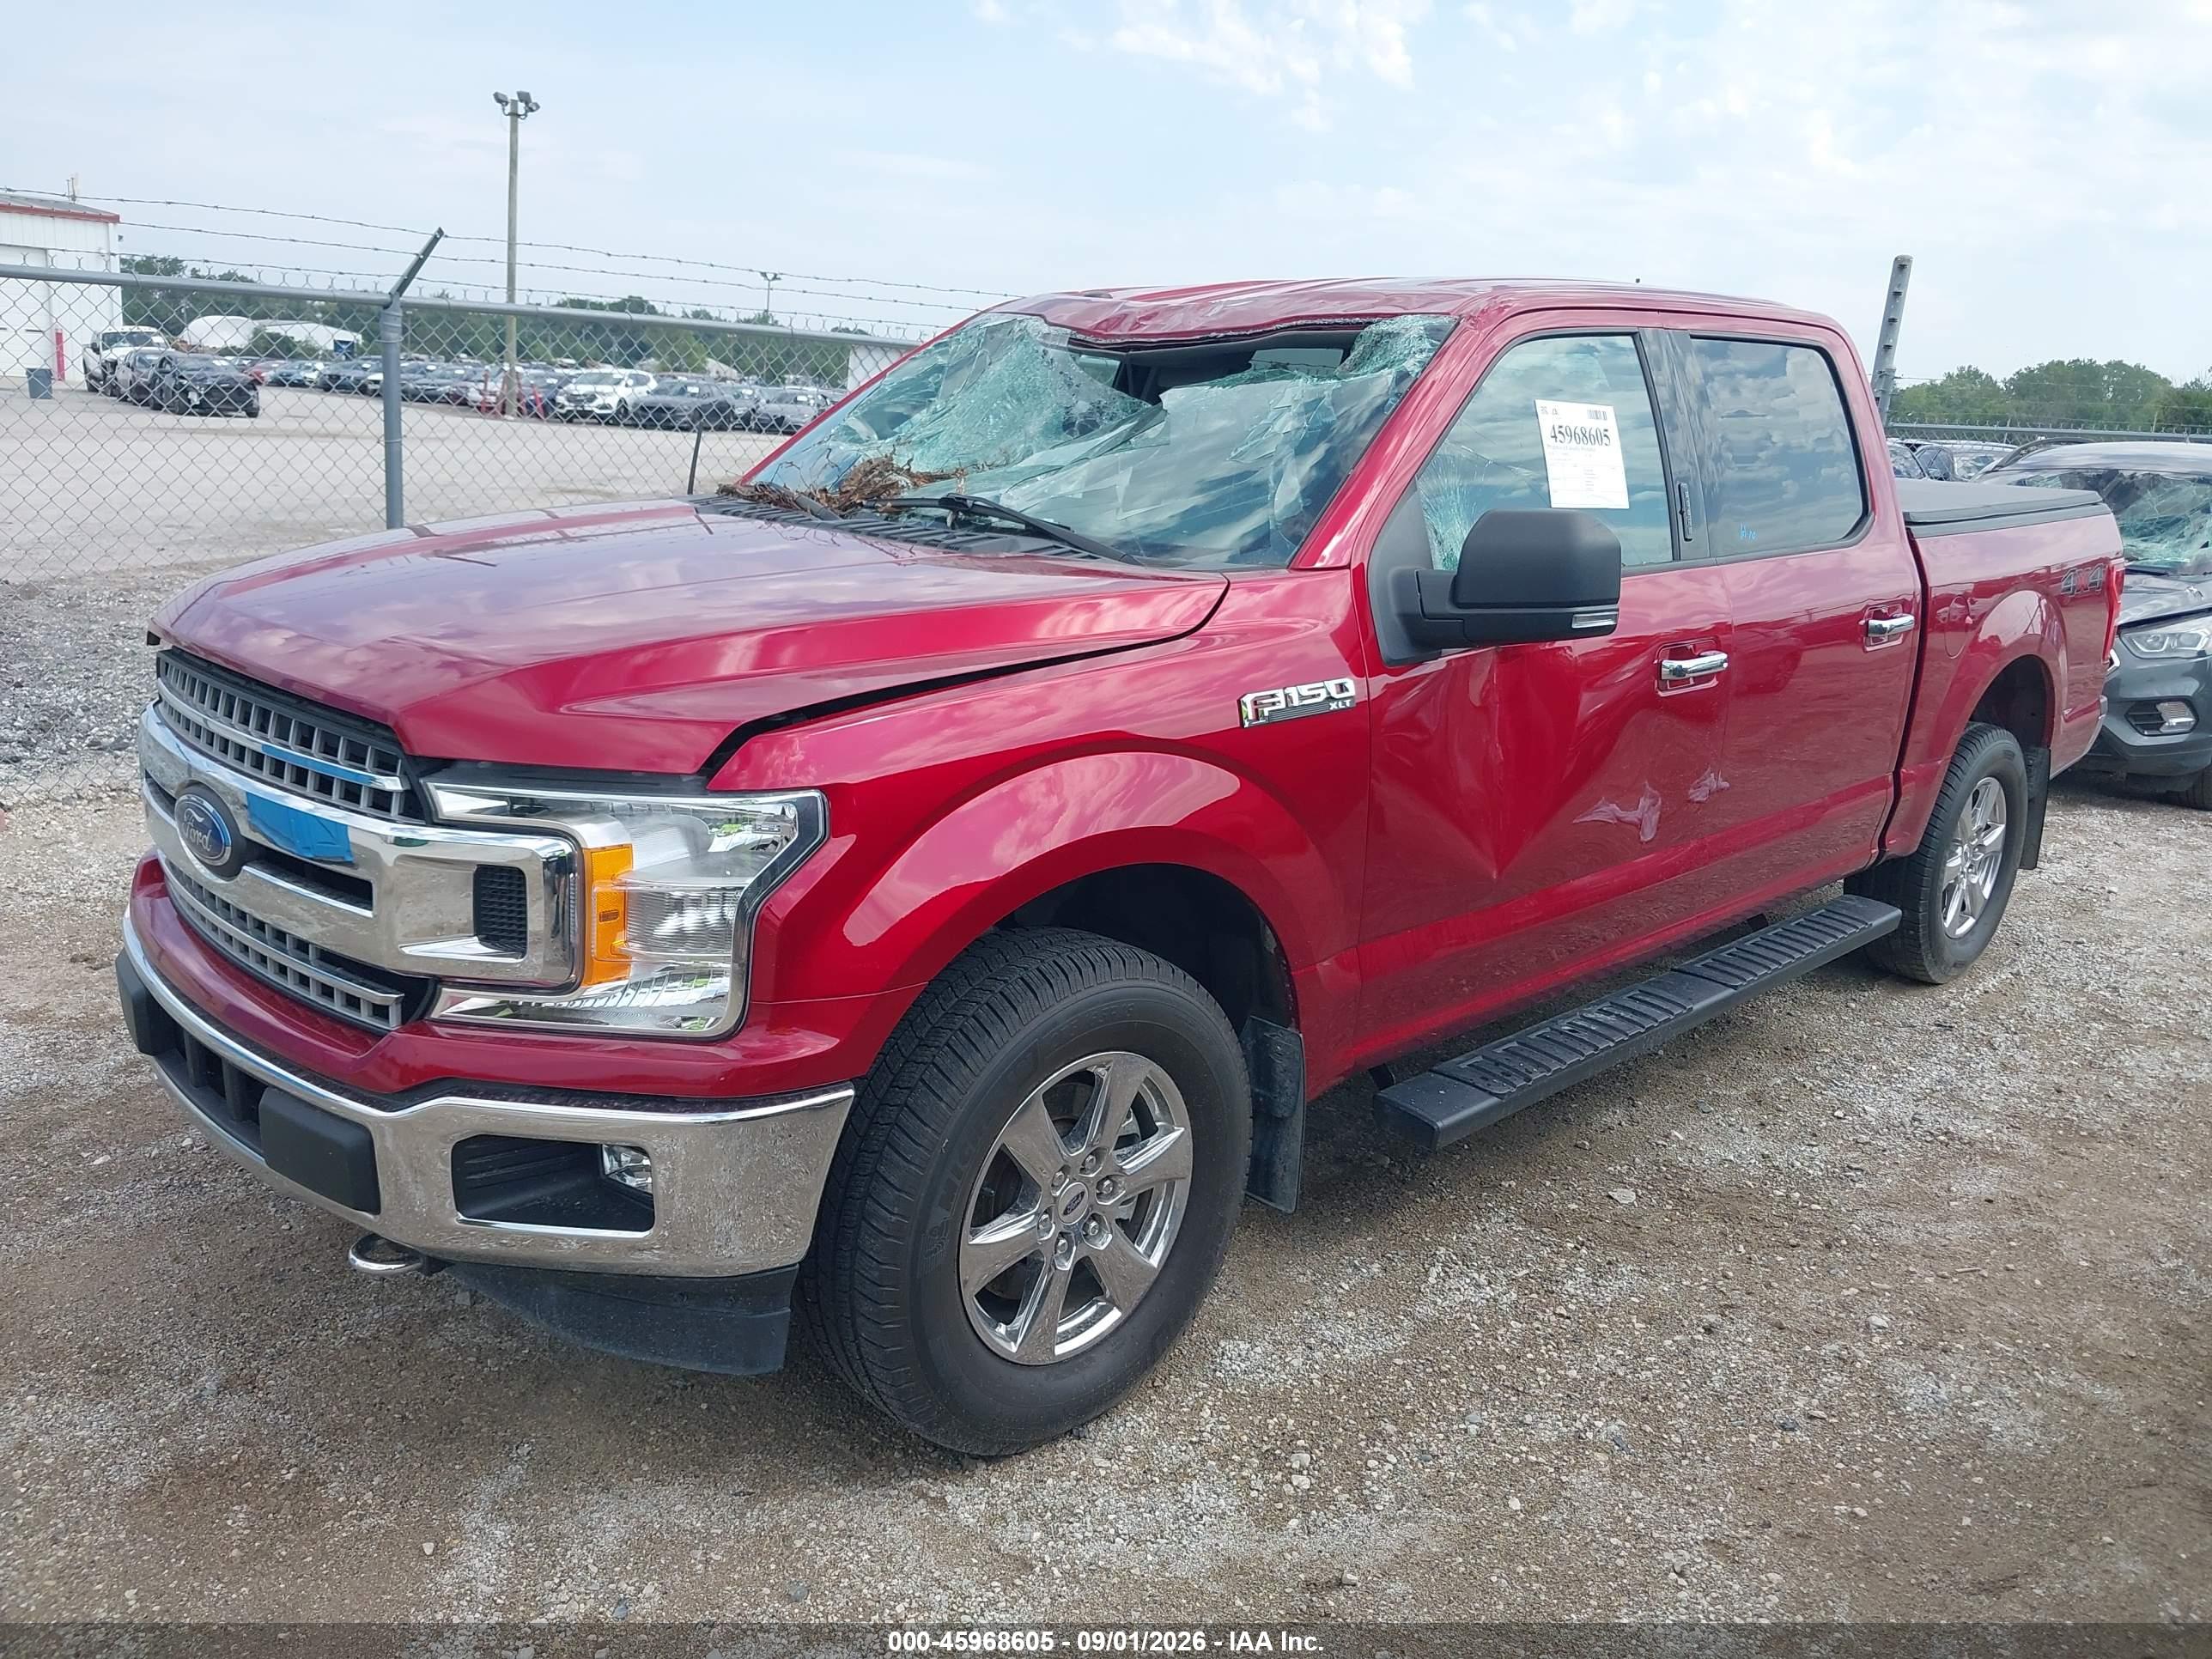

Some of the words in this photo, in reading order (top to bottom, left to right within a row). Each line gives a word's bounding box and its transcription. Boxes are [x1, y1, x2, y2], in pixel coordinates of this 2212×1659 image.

[1549, 424, 1611, 447] 45968605
[1328, 699, 1352, 711] XLT
[183, 807, 212, 852] Ford
